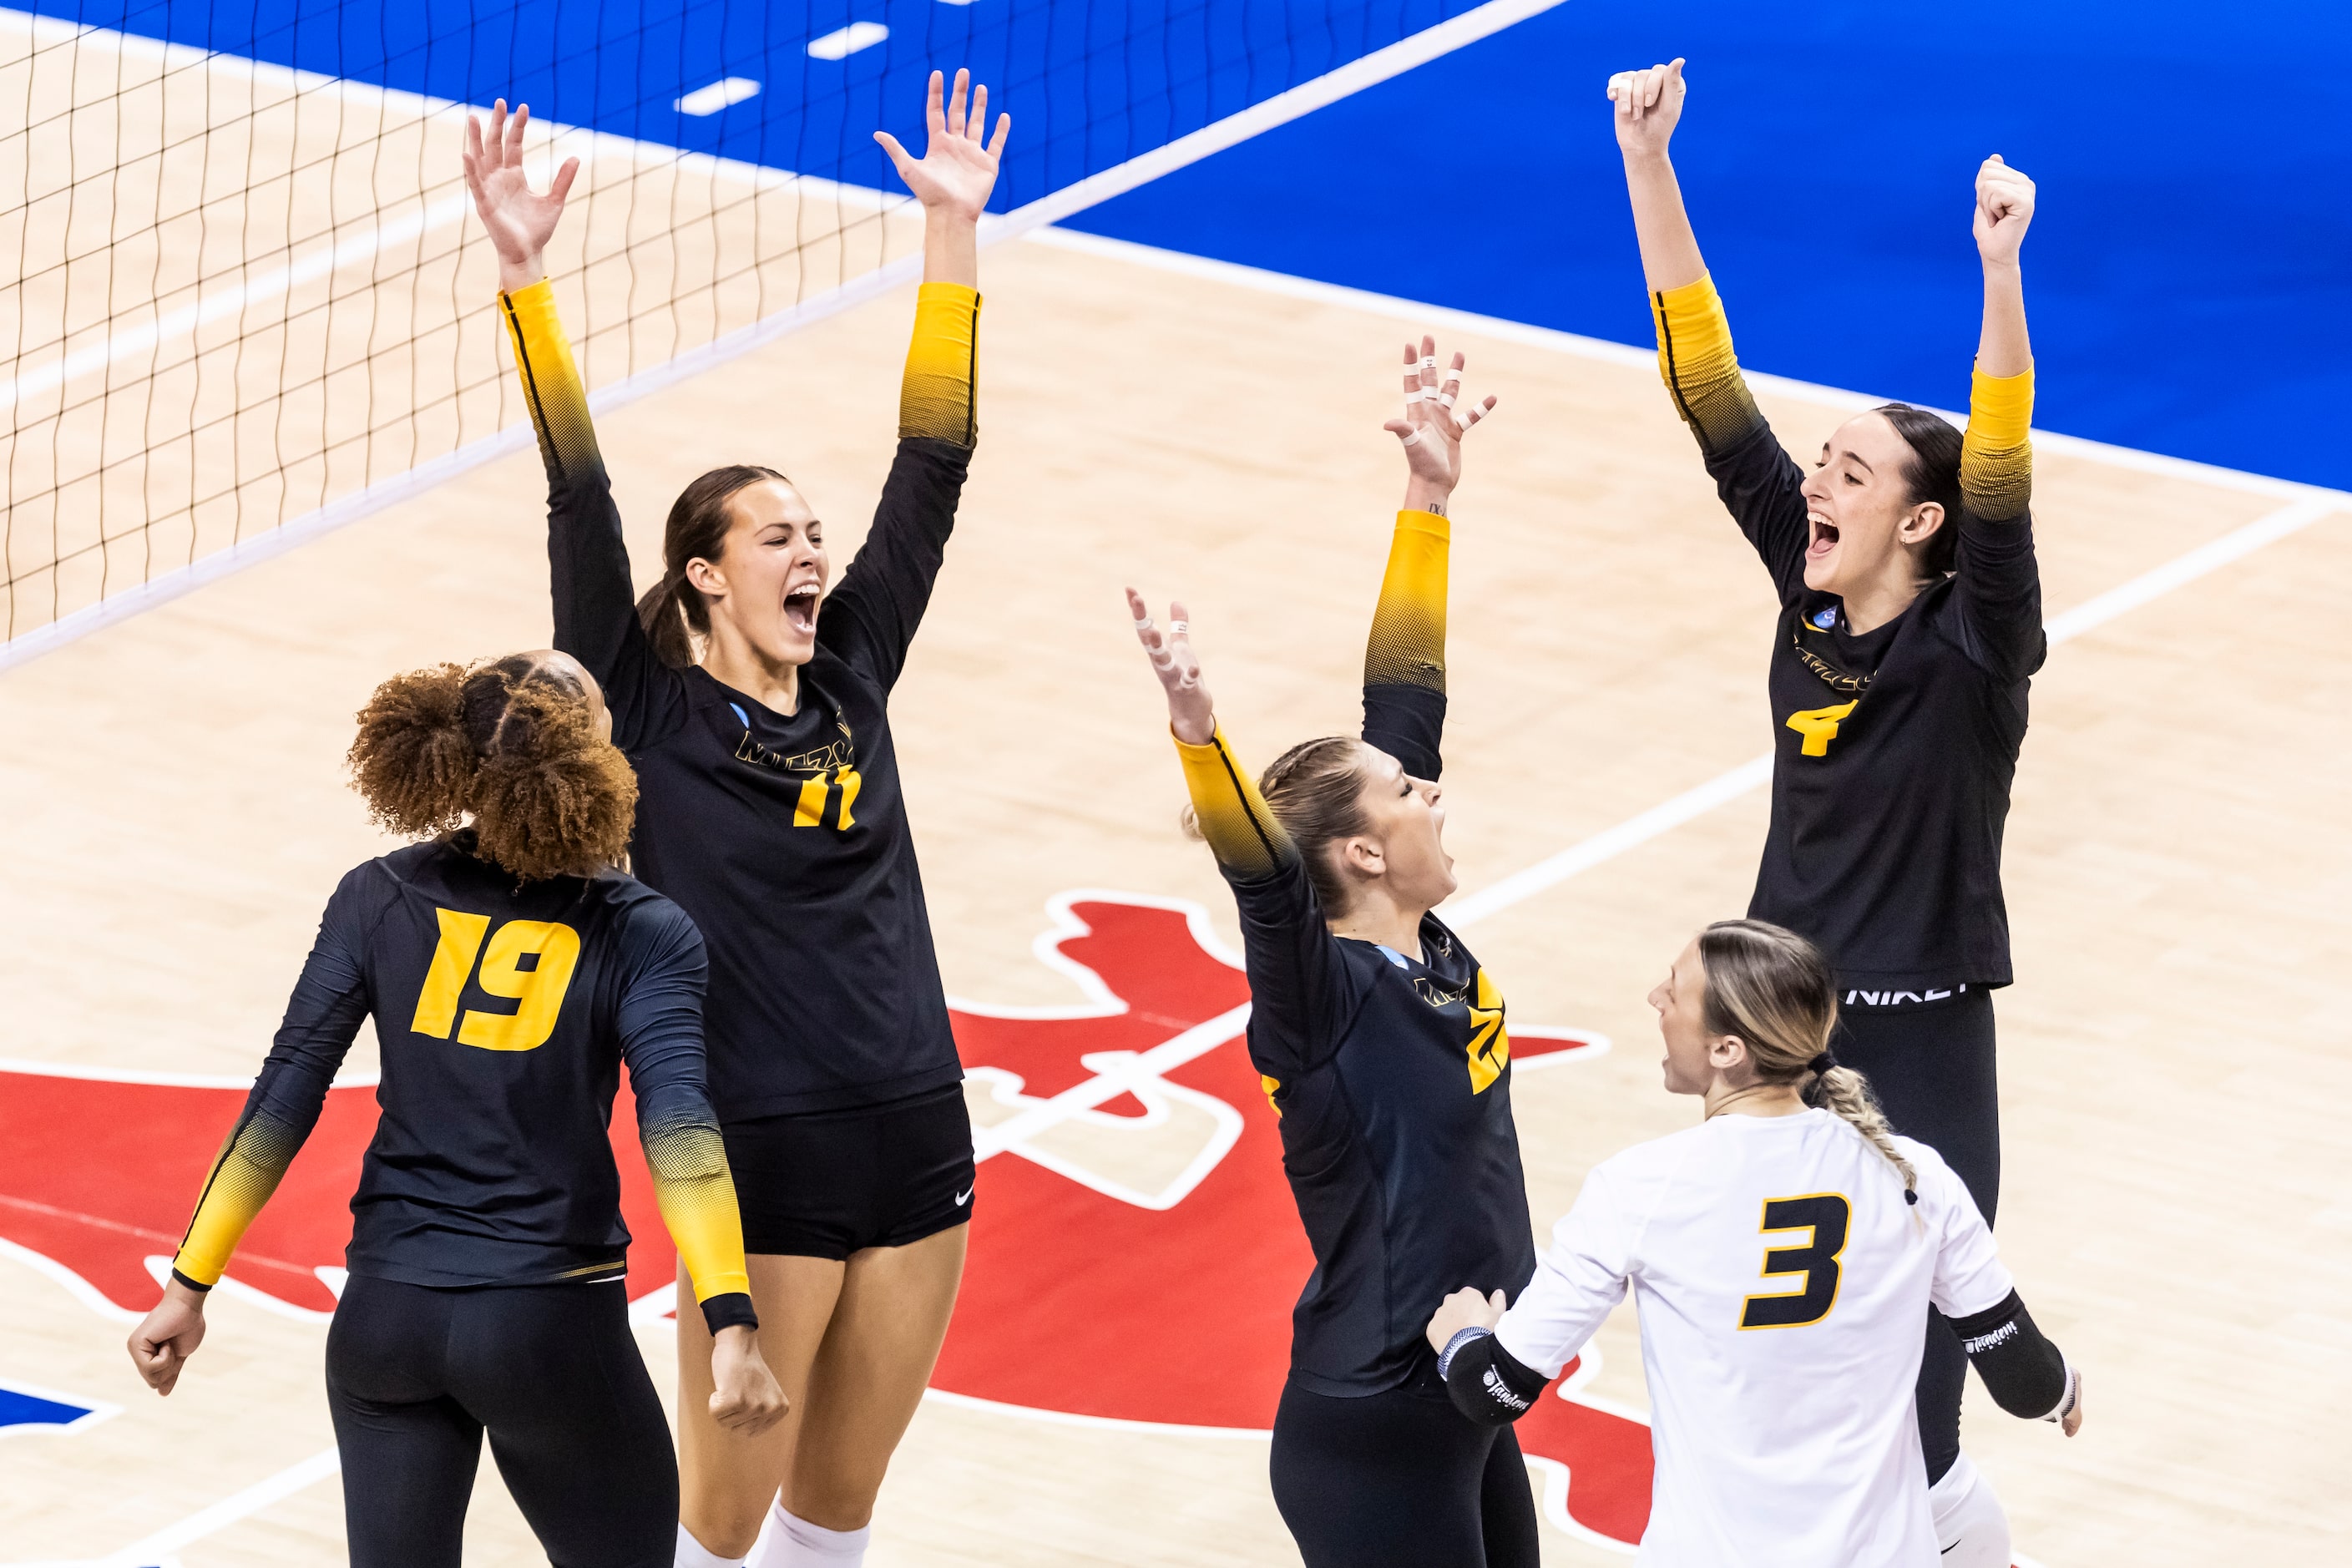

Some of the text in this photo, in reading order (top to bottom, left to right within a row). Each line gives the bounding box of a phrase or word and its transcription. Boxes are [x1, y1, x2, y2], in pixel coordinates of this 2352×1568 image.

[1786, 699, 1859, 756] 4
[793, 764, 862, 831] 11
[410, 908, 581, 1051] 19
[1737, 1191, 1852, 1331] 3
